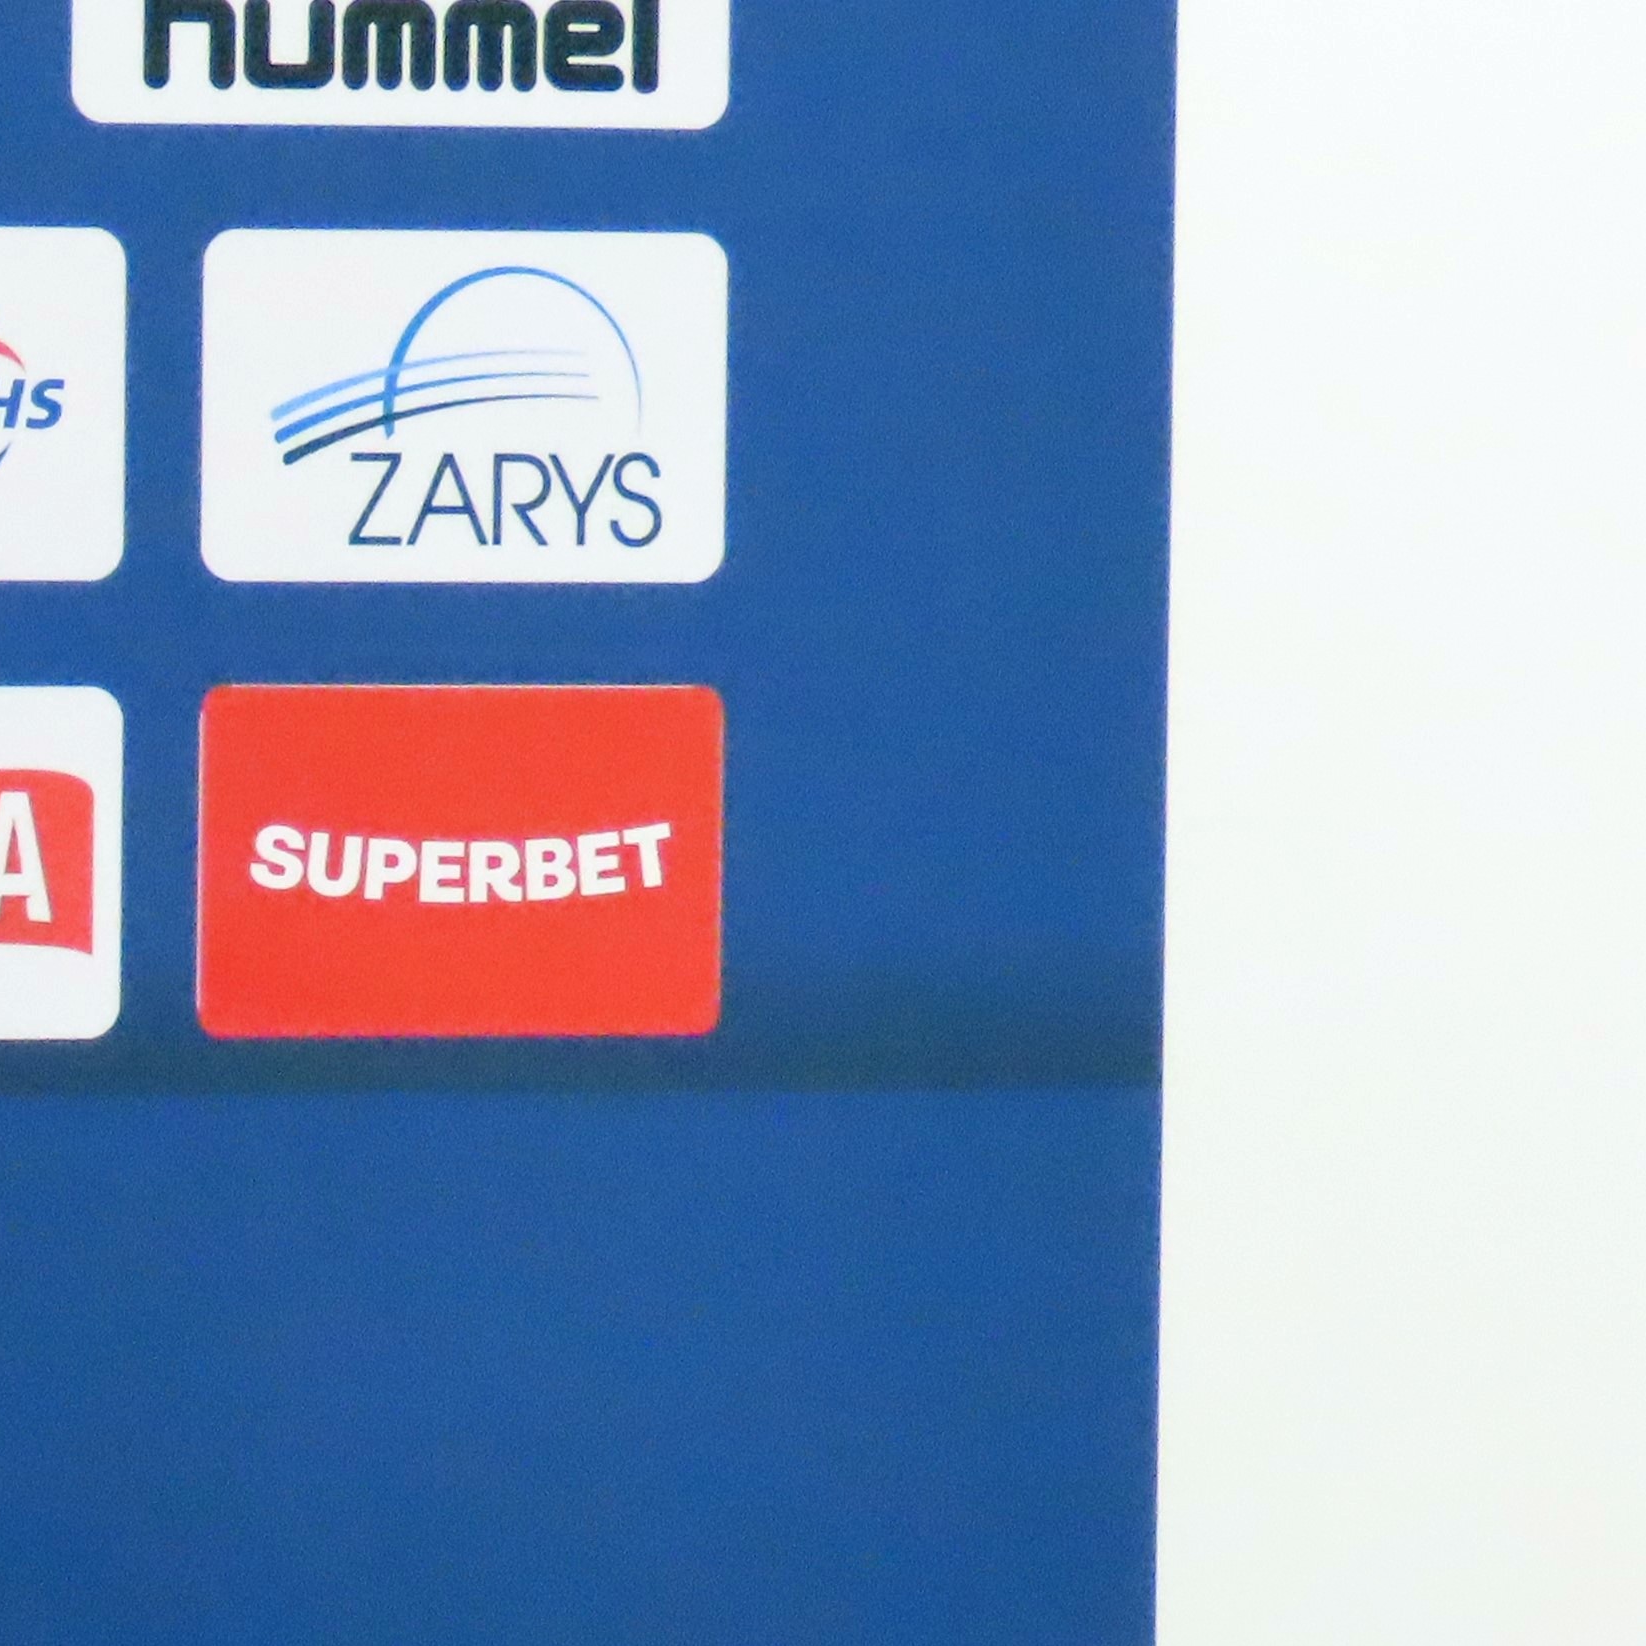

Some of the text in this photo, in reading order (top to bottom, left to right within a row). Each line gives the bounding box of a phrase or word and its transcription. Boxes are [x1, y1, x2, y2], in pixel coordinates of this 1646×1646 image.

[143, 0, 661, 94] hummel
[347, 451, 664, 548] ZARYS
[249, 823, 673, 905] SUPERBET
